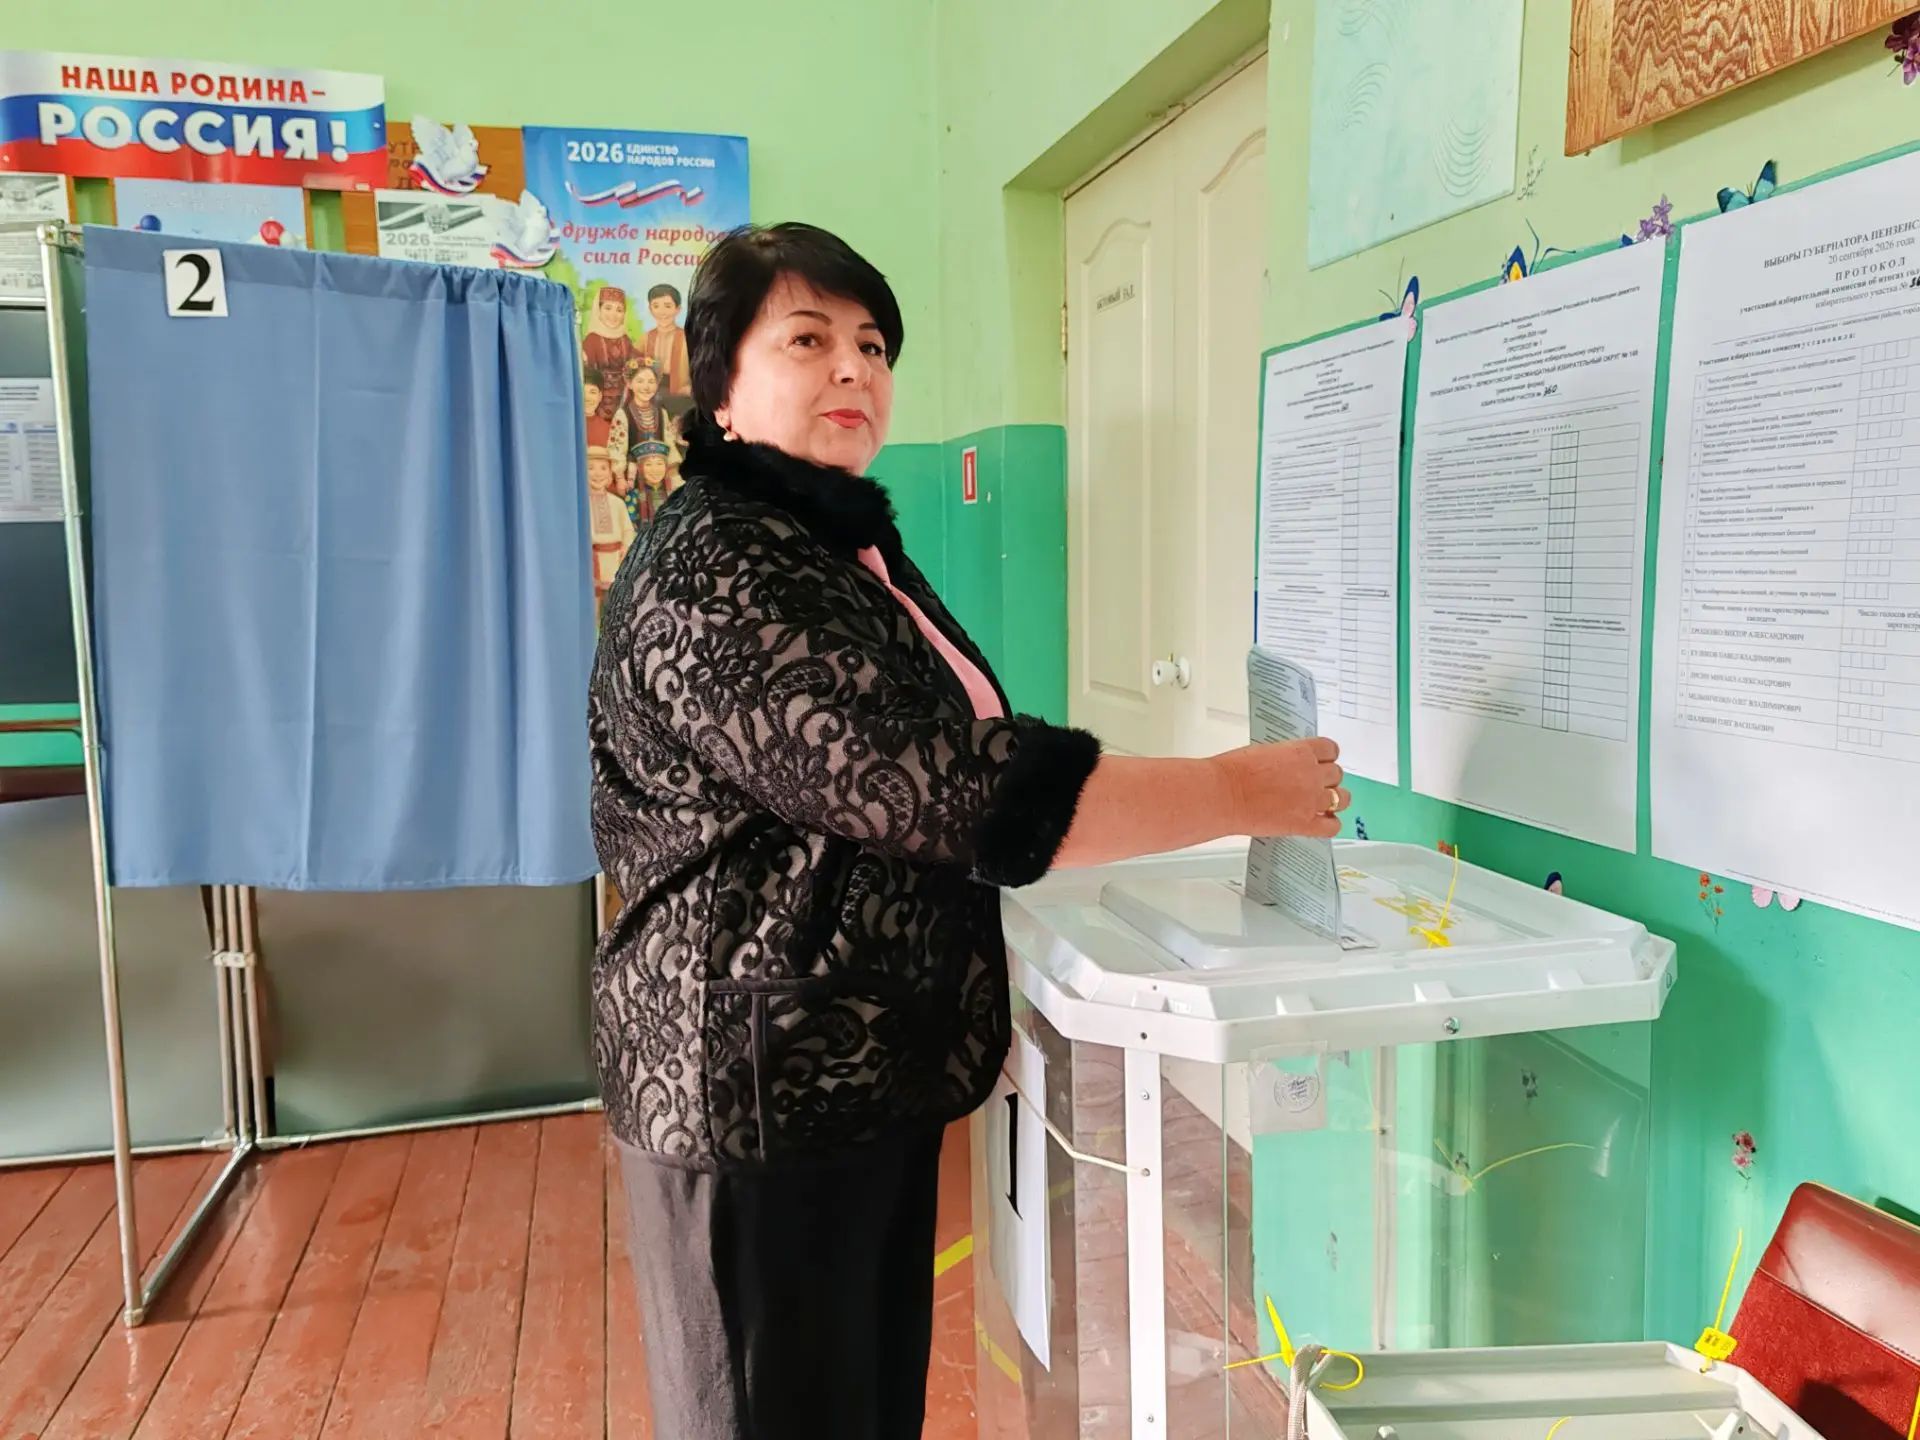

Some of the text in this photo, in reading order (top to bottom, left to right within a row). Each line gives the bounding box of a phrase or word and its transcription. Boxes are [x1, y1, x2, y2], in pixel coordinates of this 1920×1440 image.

[61, 64, 160, 95] НАША
[37, 101, 350, 163] РОССИЯ!
[567, 141, 624, 164] 2026
[626, 143, 679, 156] ЕДИНСТВО
[626, 155, 716, 169] НАРОДОВ РОССИИ
[562, 220, 639, 245] дружбе
[1764, 219, 1920, 268] ВЫБОРЫ ГУБЕРНАТОРА ПЕНЗЕНС
[583, 247, 704, 266] сила Росси
[1828, 236, 1915, 264] 20 сентября 2026 года
[175, 252, 215, 312] 2
